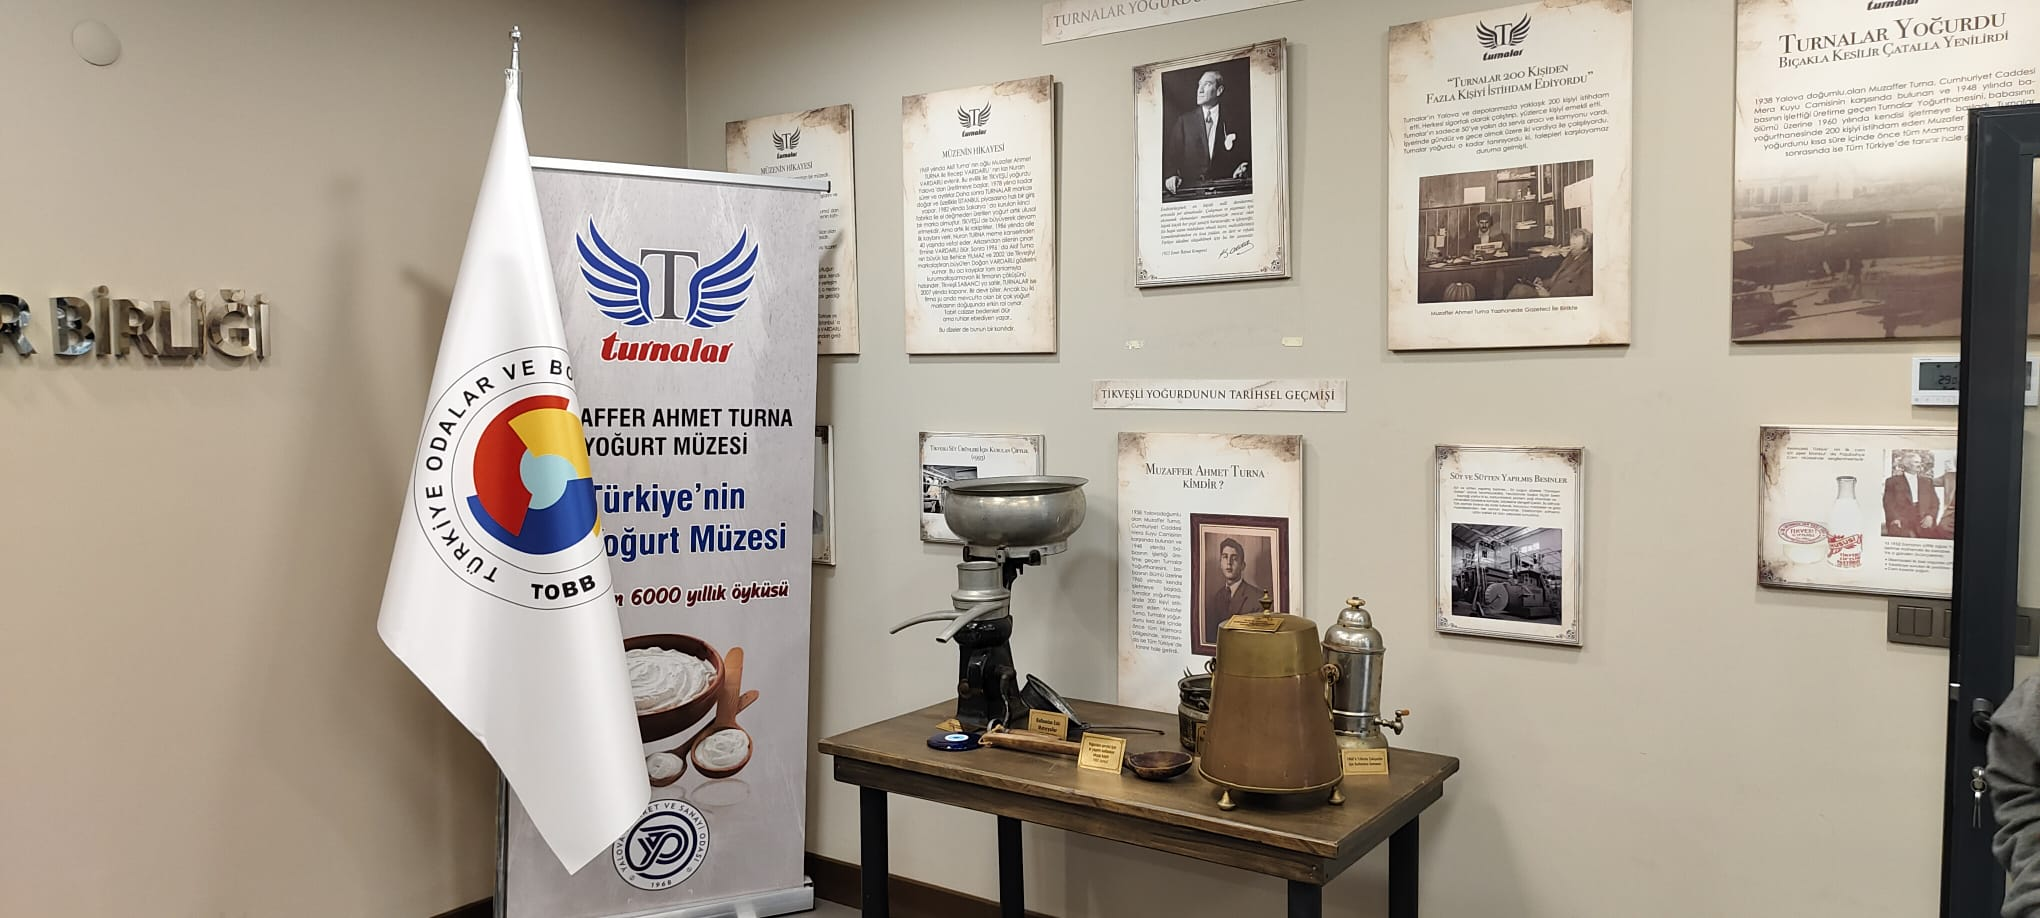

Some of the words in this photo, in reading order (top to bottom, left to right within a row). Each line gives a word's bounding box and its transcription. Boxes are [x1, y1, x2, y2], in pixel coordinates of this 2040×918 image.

[1053, 4, 1126, 29] TURNALAR
[1825, 126, 1840, 135] 200
[600, 331, 734, 363] turnalar
[502, 359, 536, 381] VE
[1145, 386, 1226, 400] YOĞURDUNUN
[1229, 388, 1283, 401] TARİHSEL
[1285, 388, 1335, 403] GEÇMİŞİ
[425, 375, 495, 471] ODALAR
[652, 408, 723, 428] AHMET
[728, 408, 793, 428] TURNA
[584, 432, 667, 457] YOĞURT
[673, 432, 748, 456] MÜZESİ
[1145, 462, 1193, 477] MUZAFFER
[1195, 464, 1229, 477] AHMET
[1231, 464, 1265, 479] TURNA
[425, 484, 499, 583] TÜRKİYE
[603, 526, 680, 563] oğurt
[690, 522, 787, 553] Müzesi
[530, 574, 596, 600] TOBB
[630, 586, 682, 606] 6000
[686, 584, 726, 607] yıllık
[732, 580, 789, 604] öyküsü
